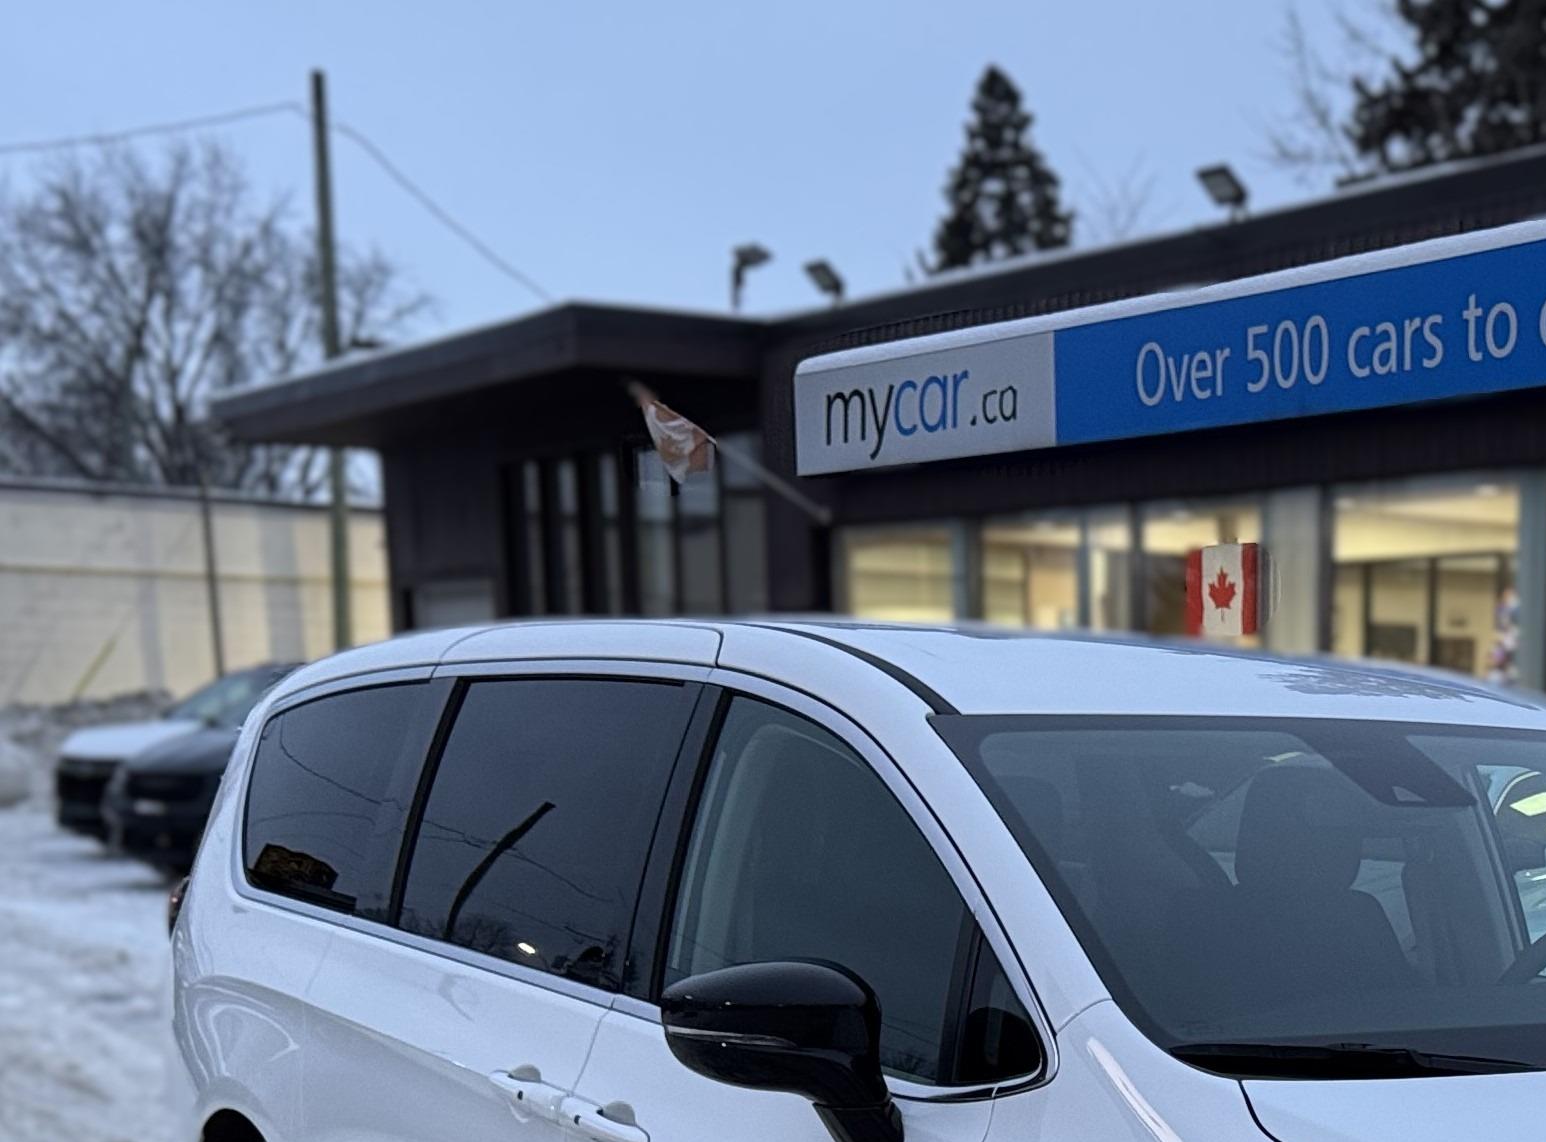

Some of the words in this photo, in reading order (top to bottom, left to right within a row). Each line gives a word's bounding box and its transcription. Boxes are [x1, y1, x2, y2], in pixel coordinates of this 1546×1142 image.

[1136, 341, 1231, 407] Over
[1246, 314, 1330, 393] 500
[1347, 314, 1444, 379] cars
[1462, 293, 1518, 362] to
[824, 368, 1019, 463] mycar.ca
